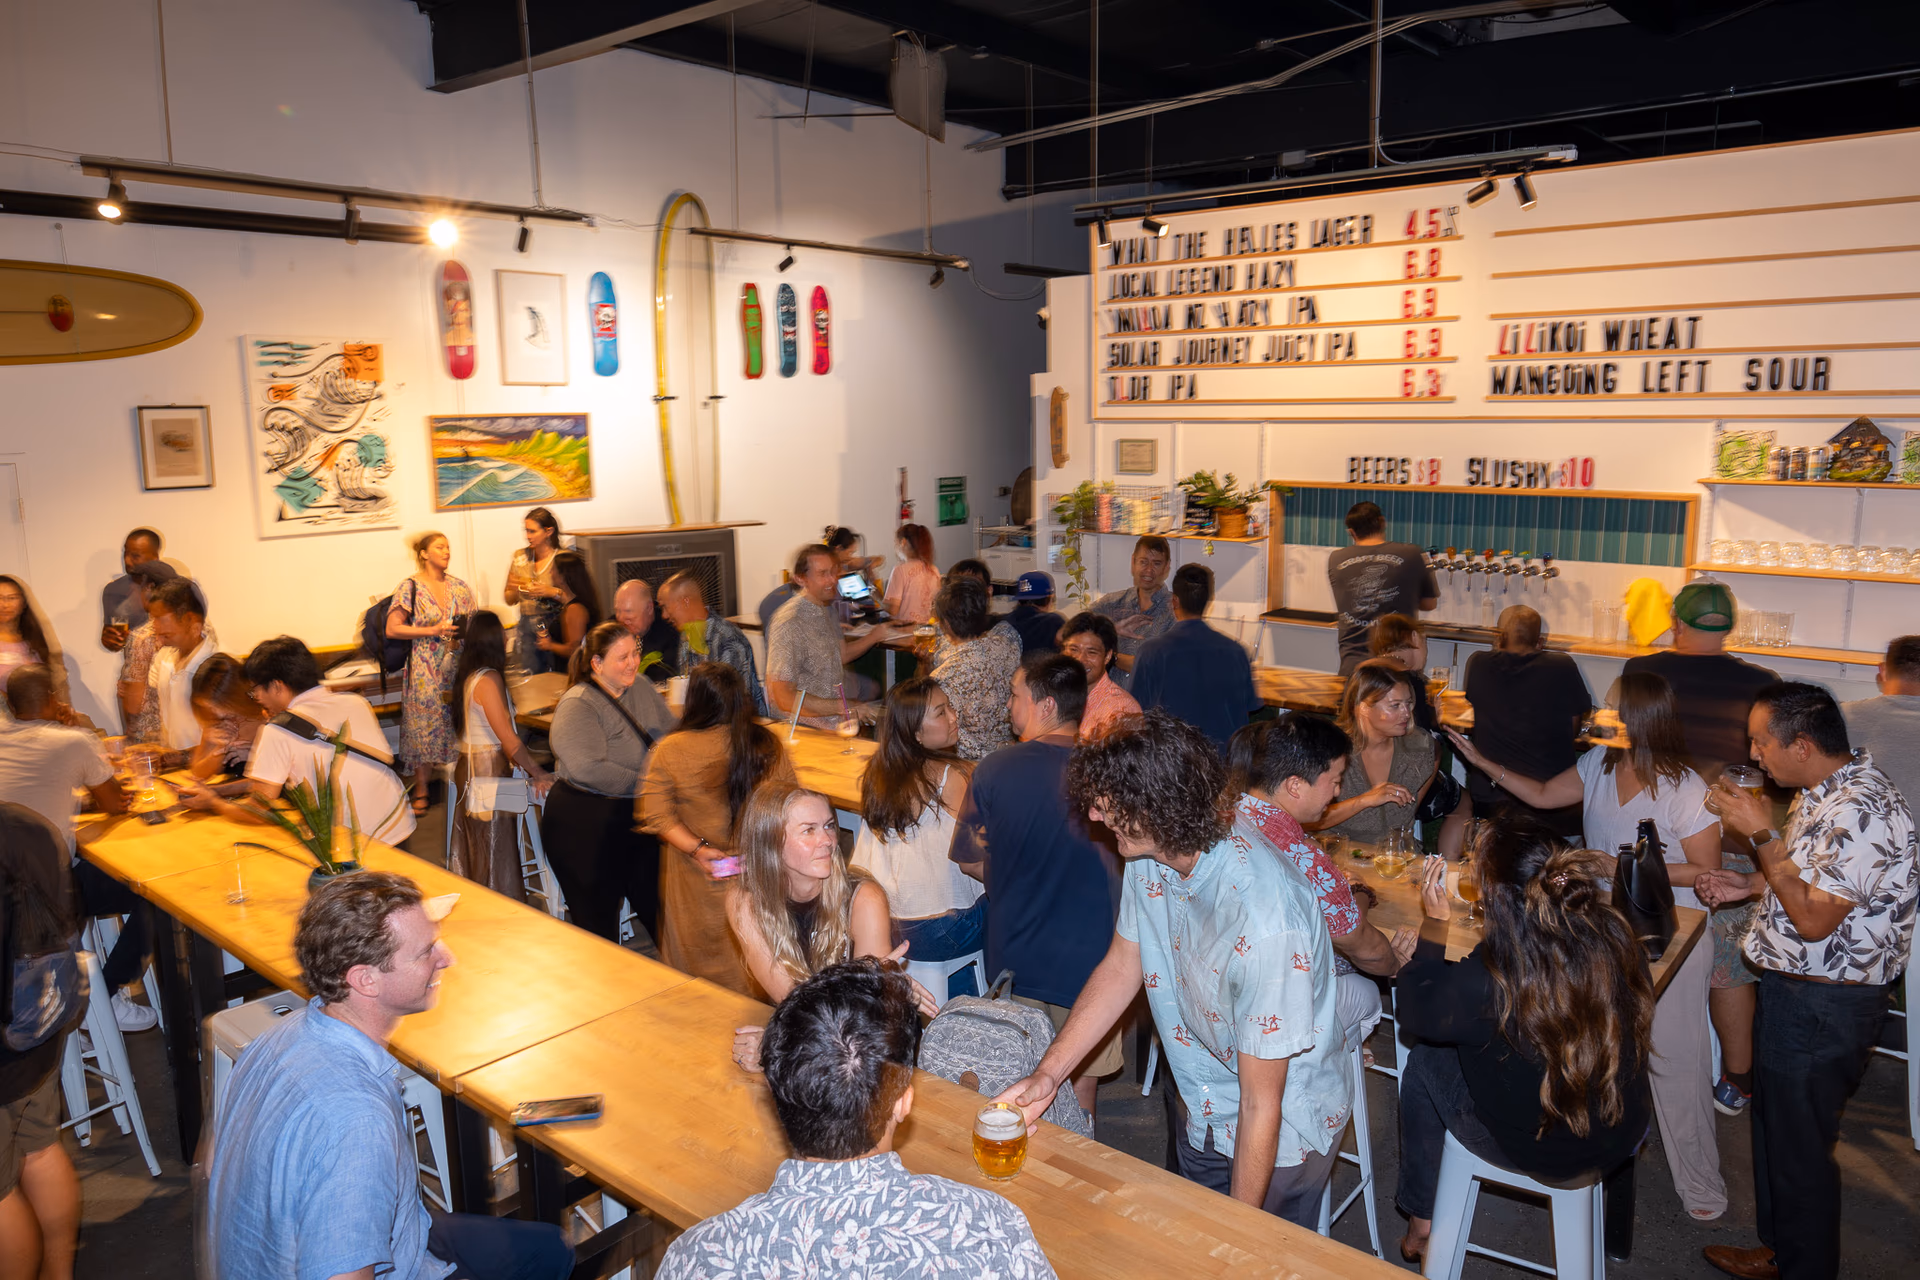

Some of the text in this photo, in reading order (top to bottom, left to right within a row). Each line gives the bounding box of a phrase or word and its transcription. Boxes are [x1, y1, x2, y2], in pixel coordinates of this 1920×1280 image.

[1112, 237, 1160, 265] WHAT
[1175, 231, 1207, 260] THE
[1311, 214, 1374, 249] LAGER
[1110, 248, 1442, 299] LOCAL LEGEND HAZY 6.8
[1109, 341, 1161, 367] SOLAR
[1174, 336, 1254, 366] JOURNEY
[1324, 331, 1357, 361] IPA
[1404, 328, 1443, 359] 6.9
[1603, 316, 1703, 352] WHEAT
[1168, 373, 1198, 400] IPA
[1643, 360, 1712, 393] LEFT
[1745, 356, 1832, 391] SOUR
[1347, 456, 1412, 485] BEERS
[1466, 456, 1596, 489] SLUSHY $10
[1338, 553, 1404, 570] CRAFT BEER
